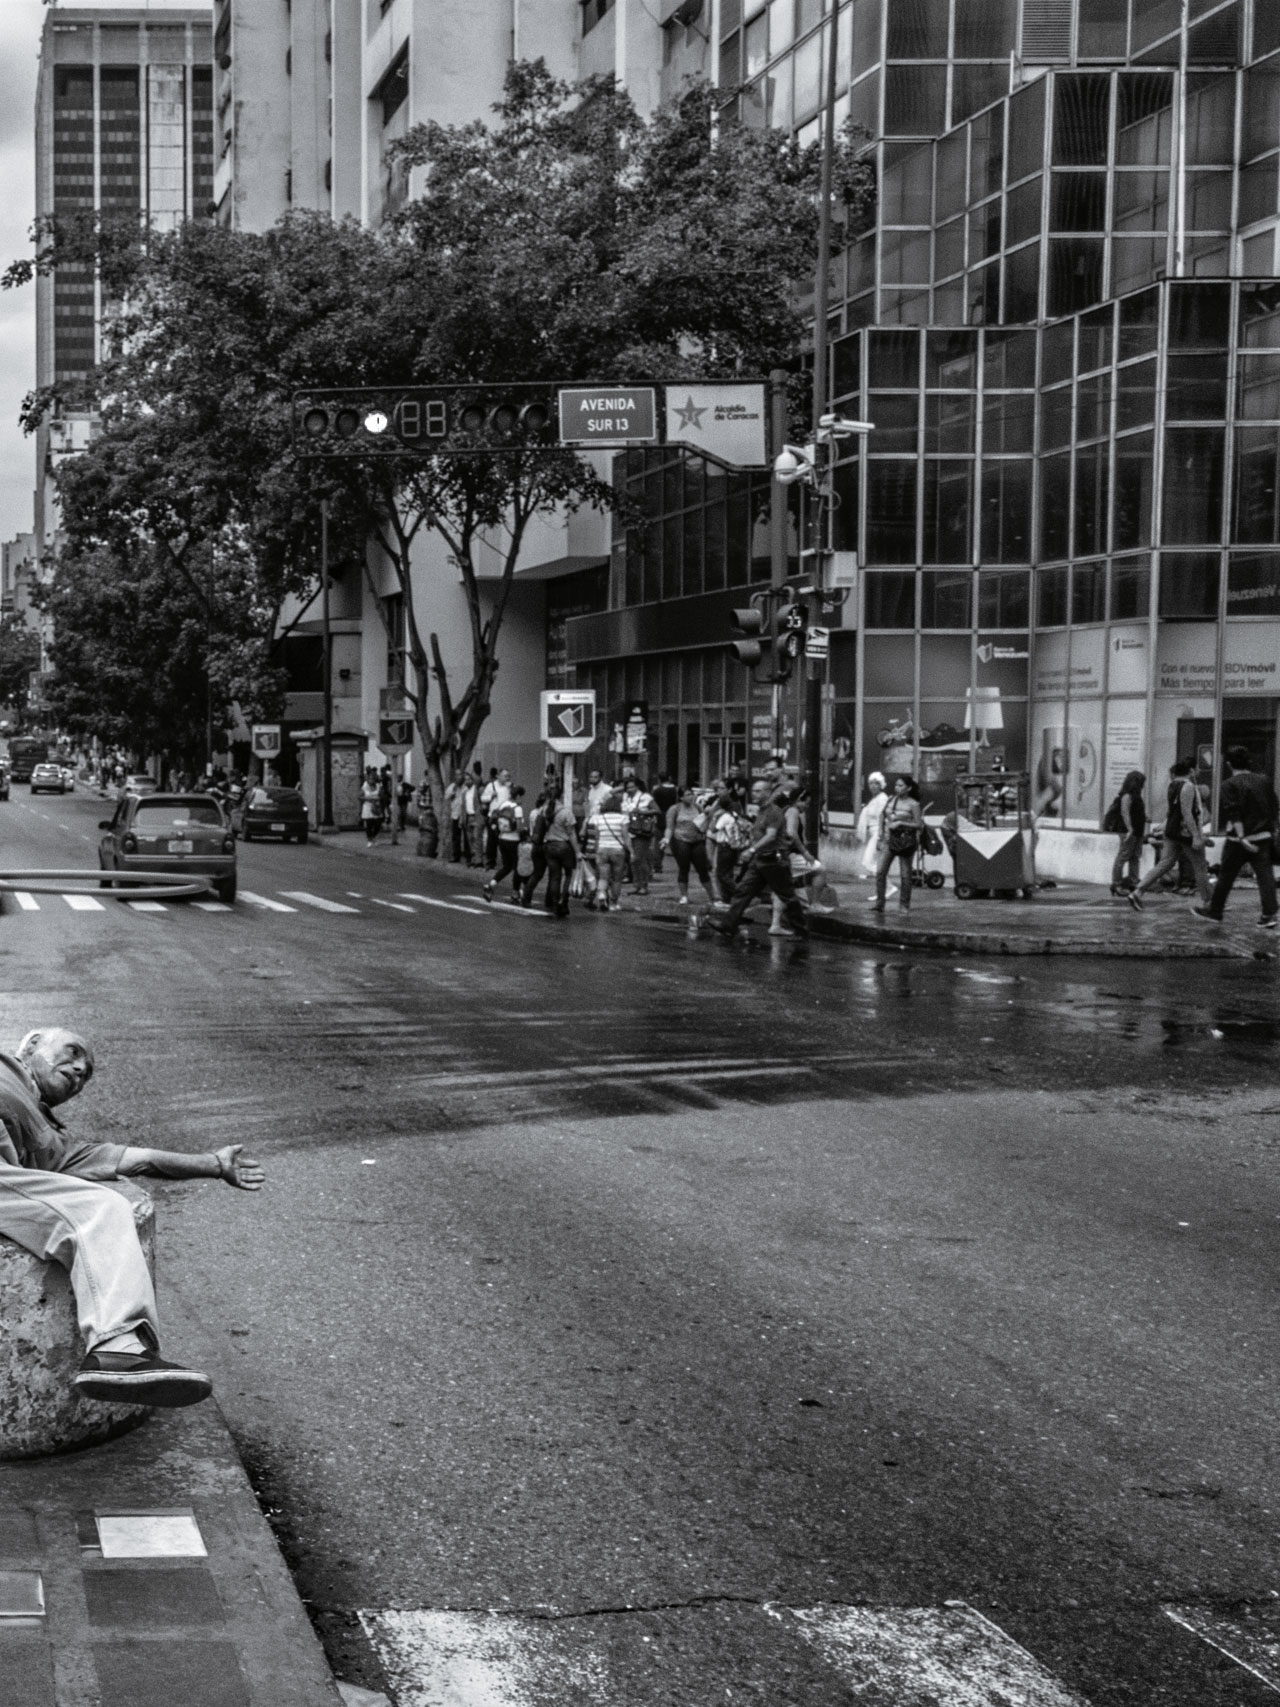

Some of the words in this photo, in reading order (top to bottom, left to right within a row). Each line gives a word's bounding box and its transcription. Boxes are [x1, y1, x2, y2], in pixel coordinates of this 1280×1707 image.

[579, 397, 635, 411] AVENIDA
[726, 411, 759, 421] Caracas
[587, 417, 613, 432] SUR
[615, 417, 629, 431] 13
[1161, 663, 1178, 673] Con
[1180, 663, 1188, 673] el
[1183, 677, 1215, 691] tiempo
[1224, 679, 1245, 689] para
